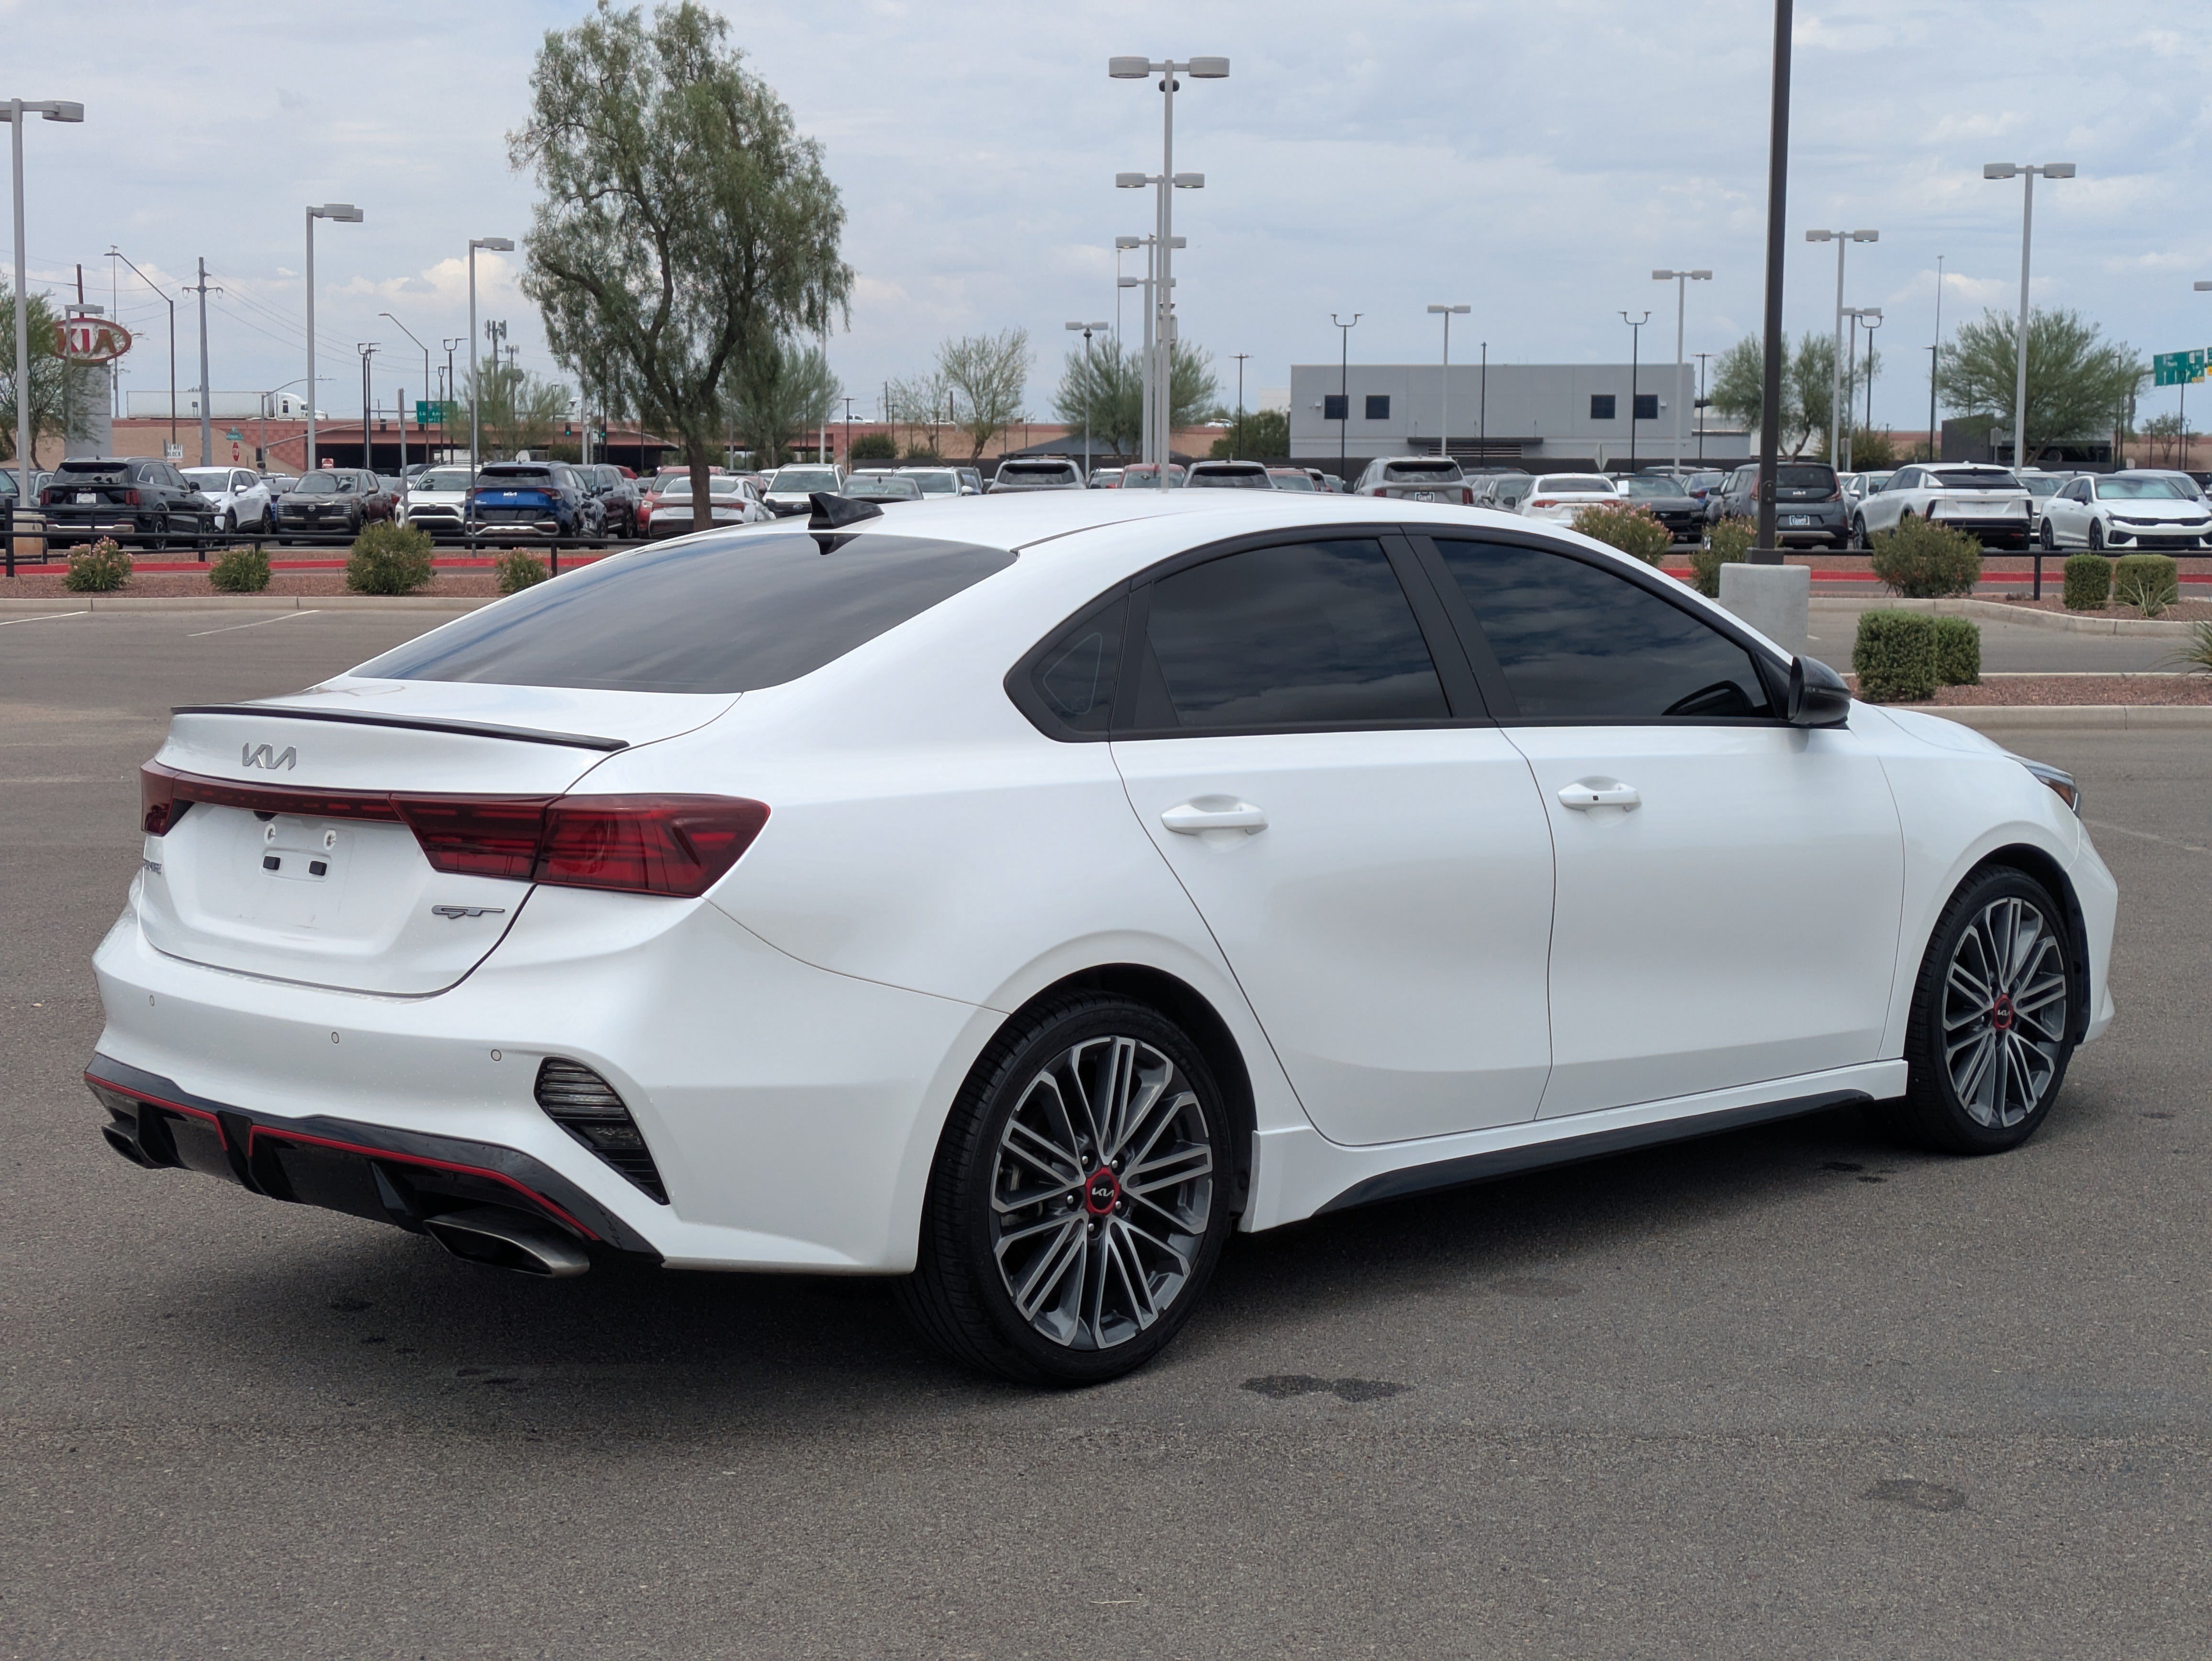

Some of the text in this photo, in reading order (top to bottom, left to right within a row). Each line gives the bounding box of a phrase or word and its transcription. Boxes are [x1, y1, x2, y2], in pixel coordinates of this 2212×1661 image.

[56, 328, 116, 353] KIA
[242, 742, 296, 770] KIA
[431, 905, 505, 919] GT
[1092, 1187, 1115, 1197] KIA
